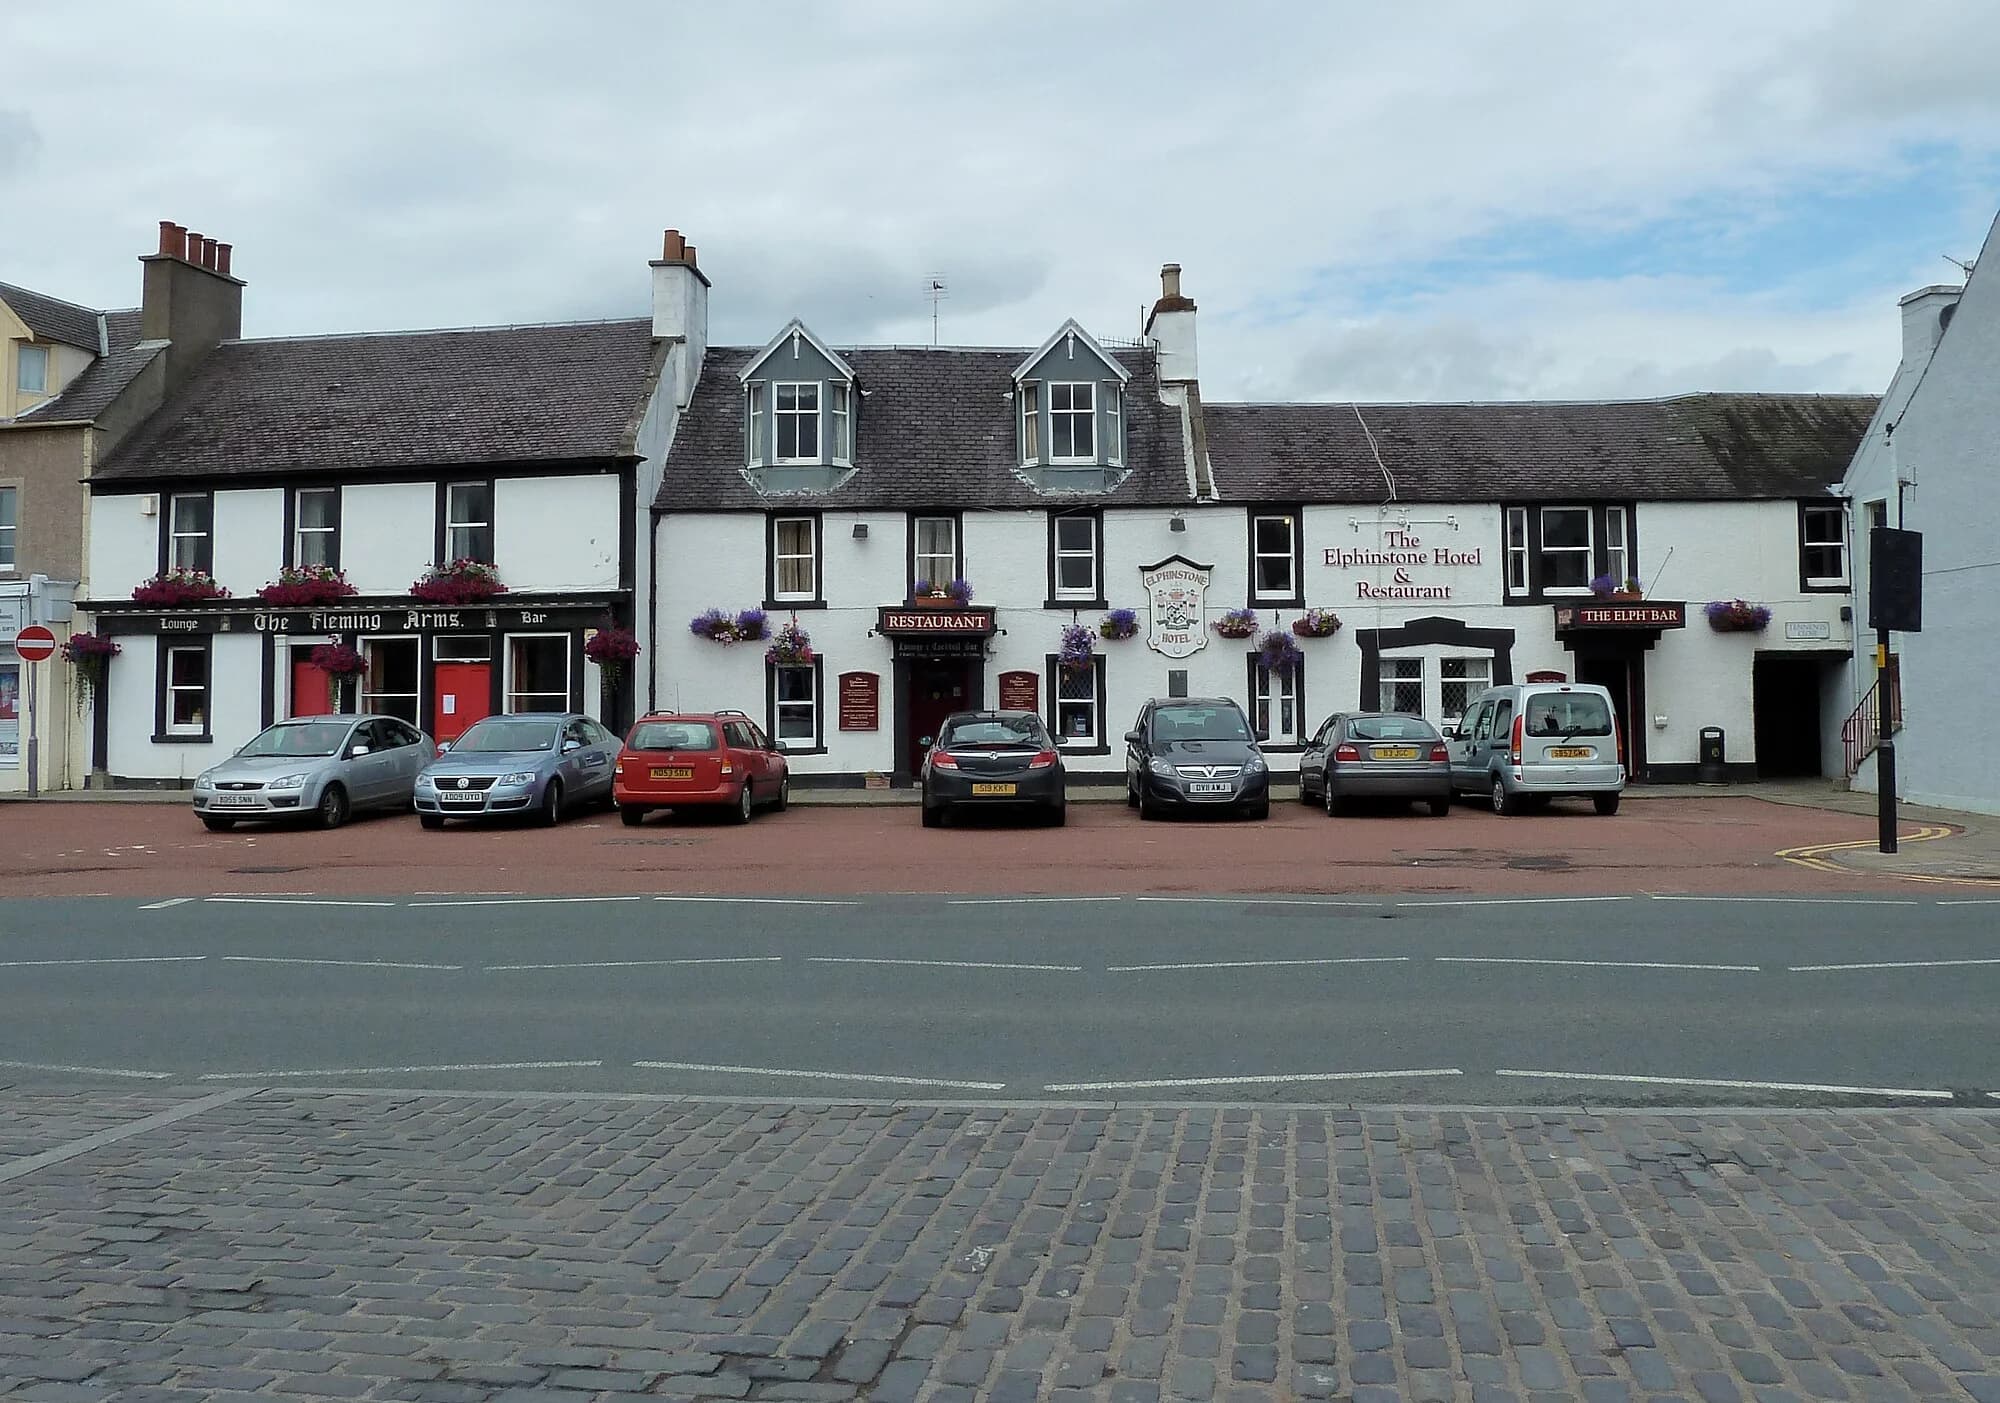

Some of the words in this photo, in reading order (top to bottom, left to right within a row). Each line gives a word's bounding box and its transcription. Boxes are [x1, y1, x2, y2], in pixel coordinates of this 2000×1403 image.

[1385, 530, 1420, 547] The
[1324, 548, 1427, 569] Elphinstone
[1433, 548, 1481, 565] Hotel
[1145, 570, 1208, 587] ELPHINSTONE
[1393, 567, 1412, 583] &
[1356, 582, 1451, 598] Restaurant
[254, 613, 289, 631] The
[308, 612, 381, 631] Fleming
[520, 611, 547, 624] Bar
[888, 615, 986, 628] RESTAURANT
[1651, 609, 1677, 620] BAR
[159, 618, 198, 631] Lounge
[1161, 633, 1190, 643] HOTEL
